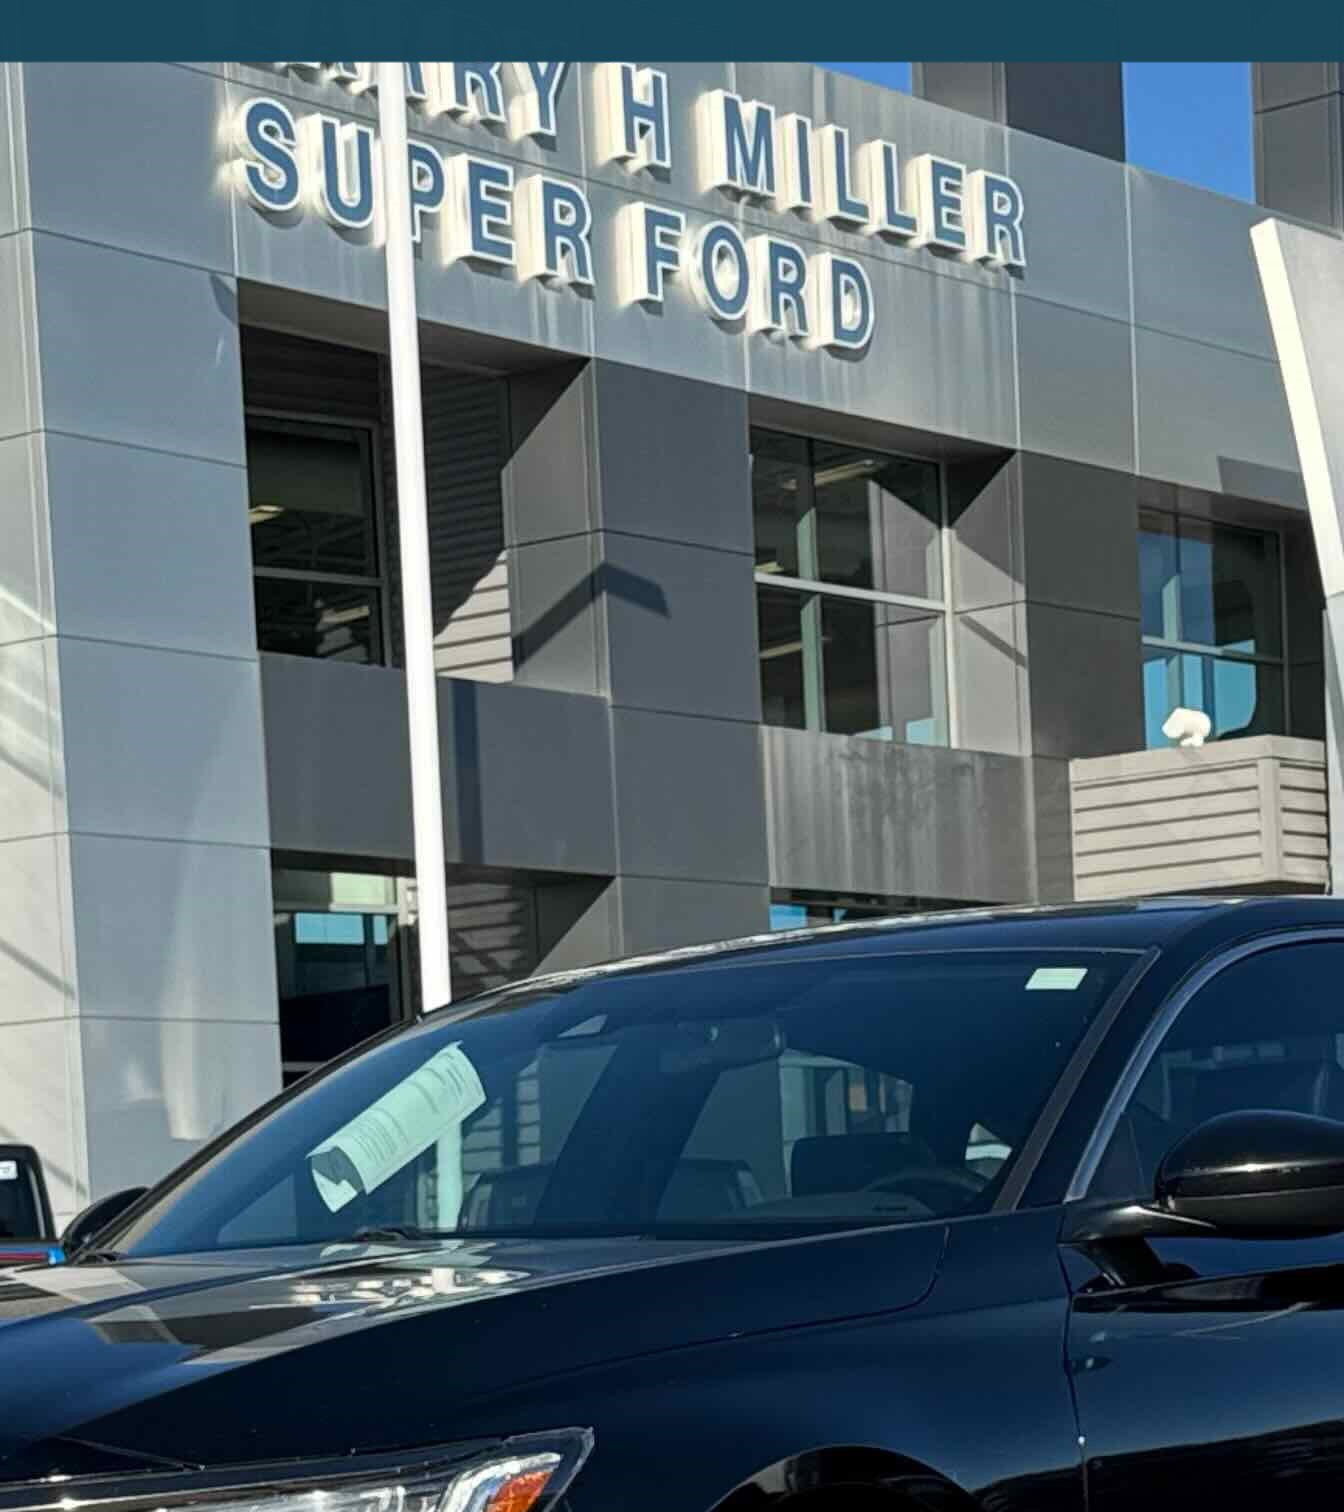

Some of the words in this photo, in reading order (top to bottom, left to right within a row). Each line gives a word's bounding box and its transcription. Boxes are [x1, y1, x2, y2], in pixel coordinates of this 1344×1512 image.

[242, 97, 593, 287] SUPER
[628, 201, 876, 350] FORD
[606, 62, 673, 170] H
[708, 89, 1026, 268] MILLER
